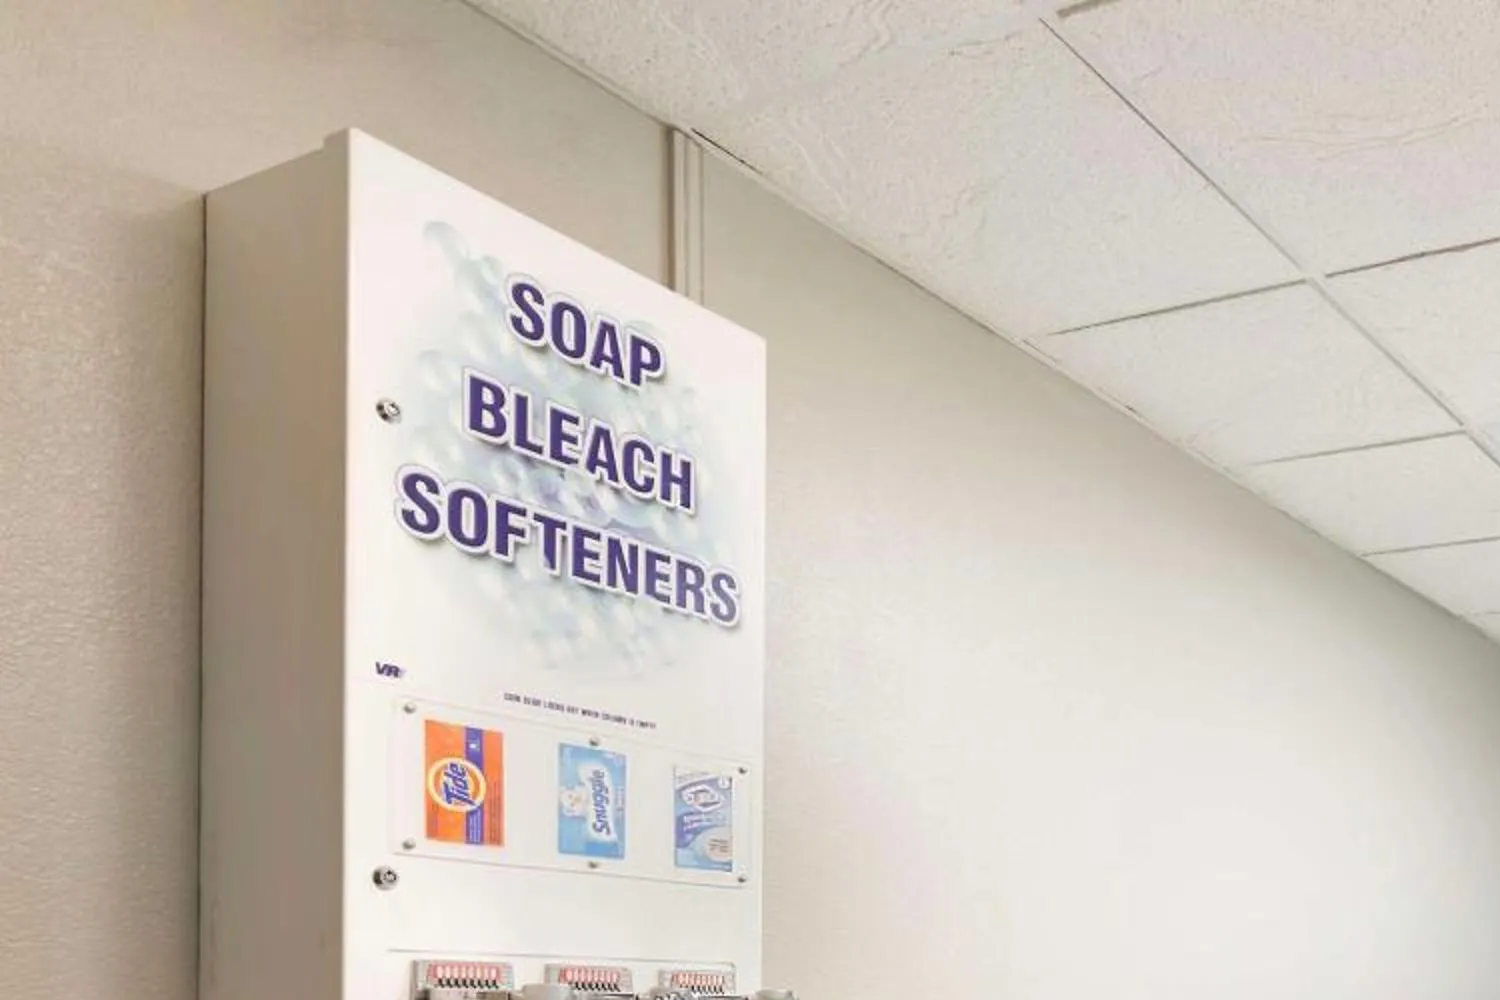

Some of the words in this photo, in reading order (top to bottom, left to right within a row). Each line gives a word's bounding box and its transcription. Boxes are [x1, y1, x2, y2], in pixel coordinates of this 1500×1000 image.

[510, 281, 663, 387] SOAP
[467, 373, 694, 510] BLEACH
[400, 471, 739, 624] SOFTENERS
[443, 762, 476, 805] Tide
[588, 768, 610, 836] Snuggle
